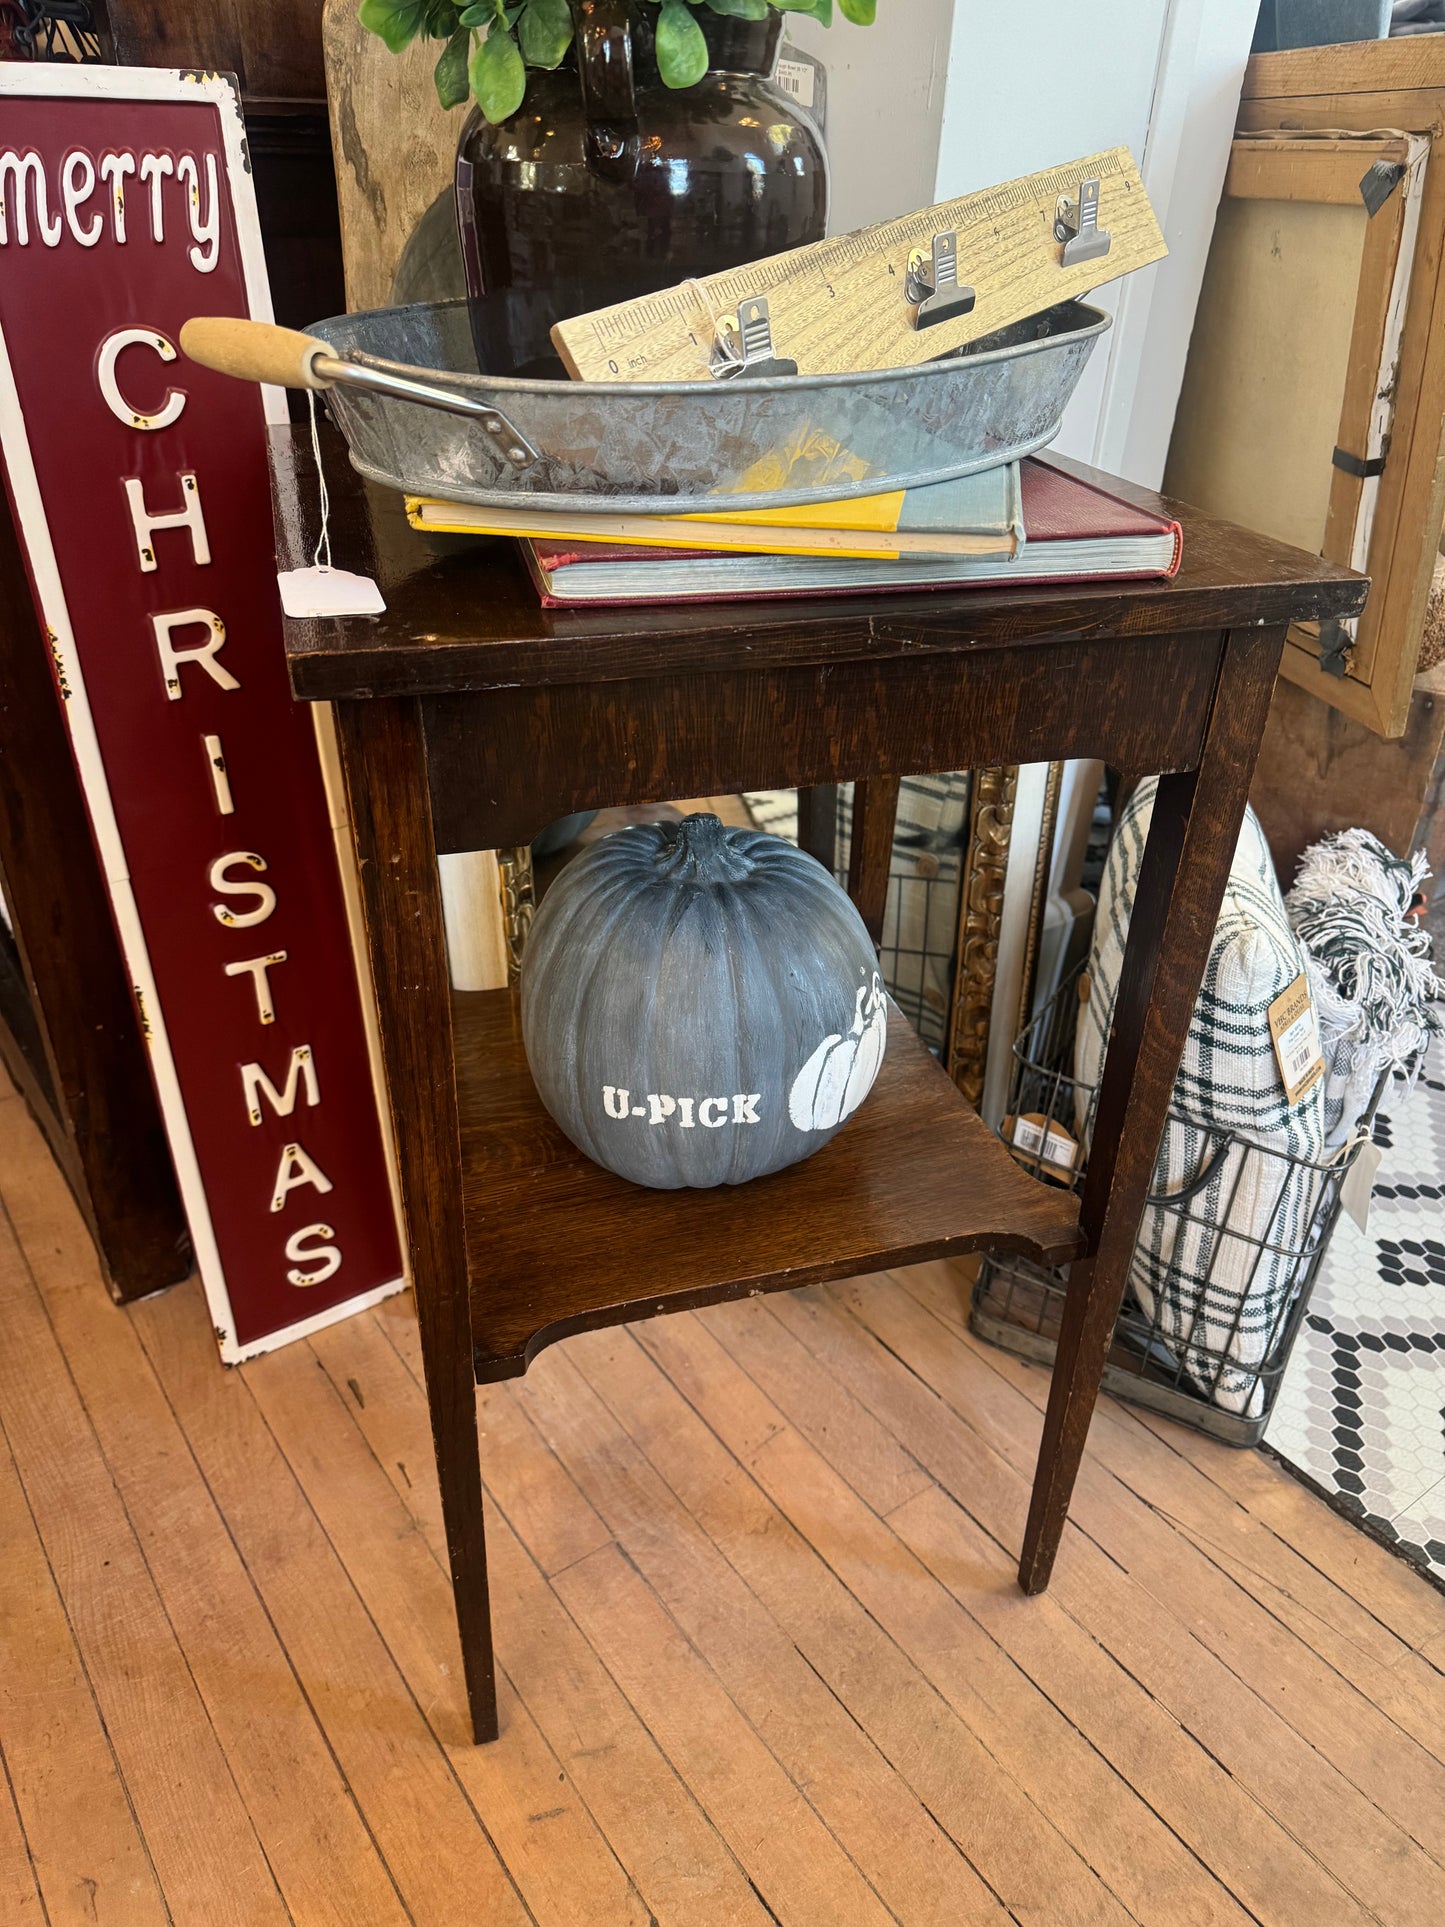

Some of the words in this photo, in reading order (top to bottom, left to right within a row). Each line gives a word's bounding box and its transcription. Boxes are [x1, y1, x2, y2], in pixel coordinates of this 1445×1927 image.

[0, 151, 220, 273] merry
[826, 285, 836, 298] 3
[887, 263, 896, 277] 4
[993, 226, 1001, 238] 6
[1039, 211, 1046, 222] 7
[1124, 180, 1131, 192] 9
[627, 353, 648, 369] inch
[602, 1085, 762, 1128] U-PICK
